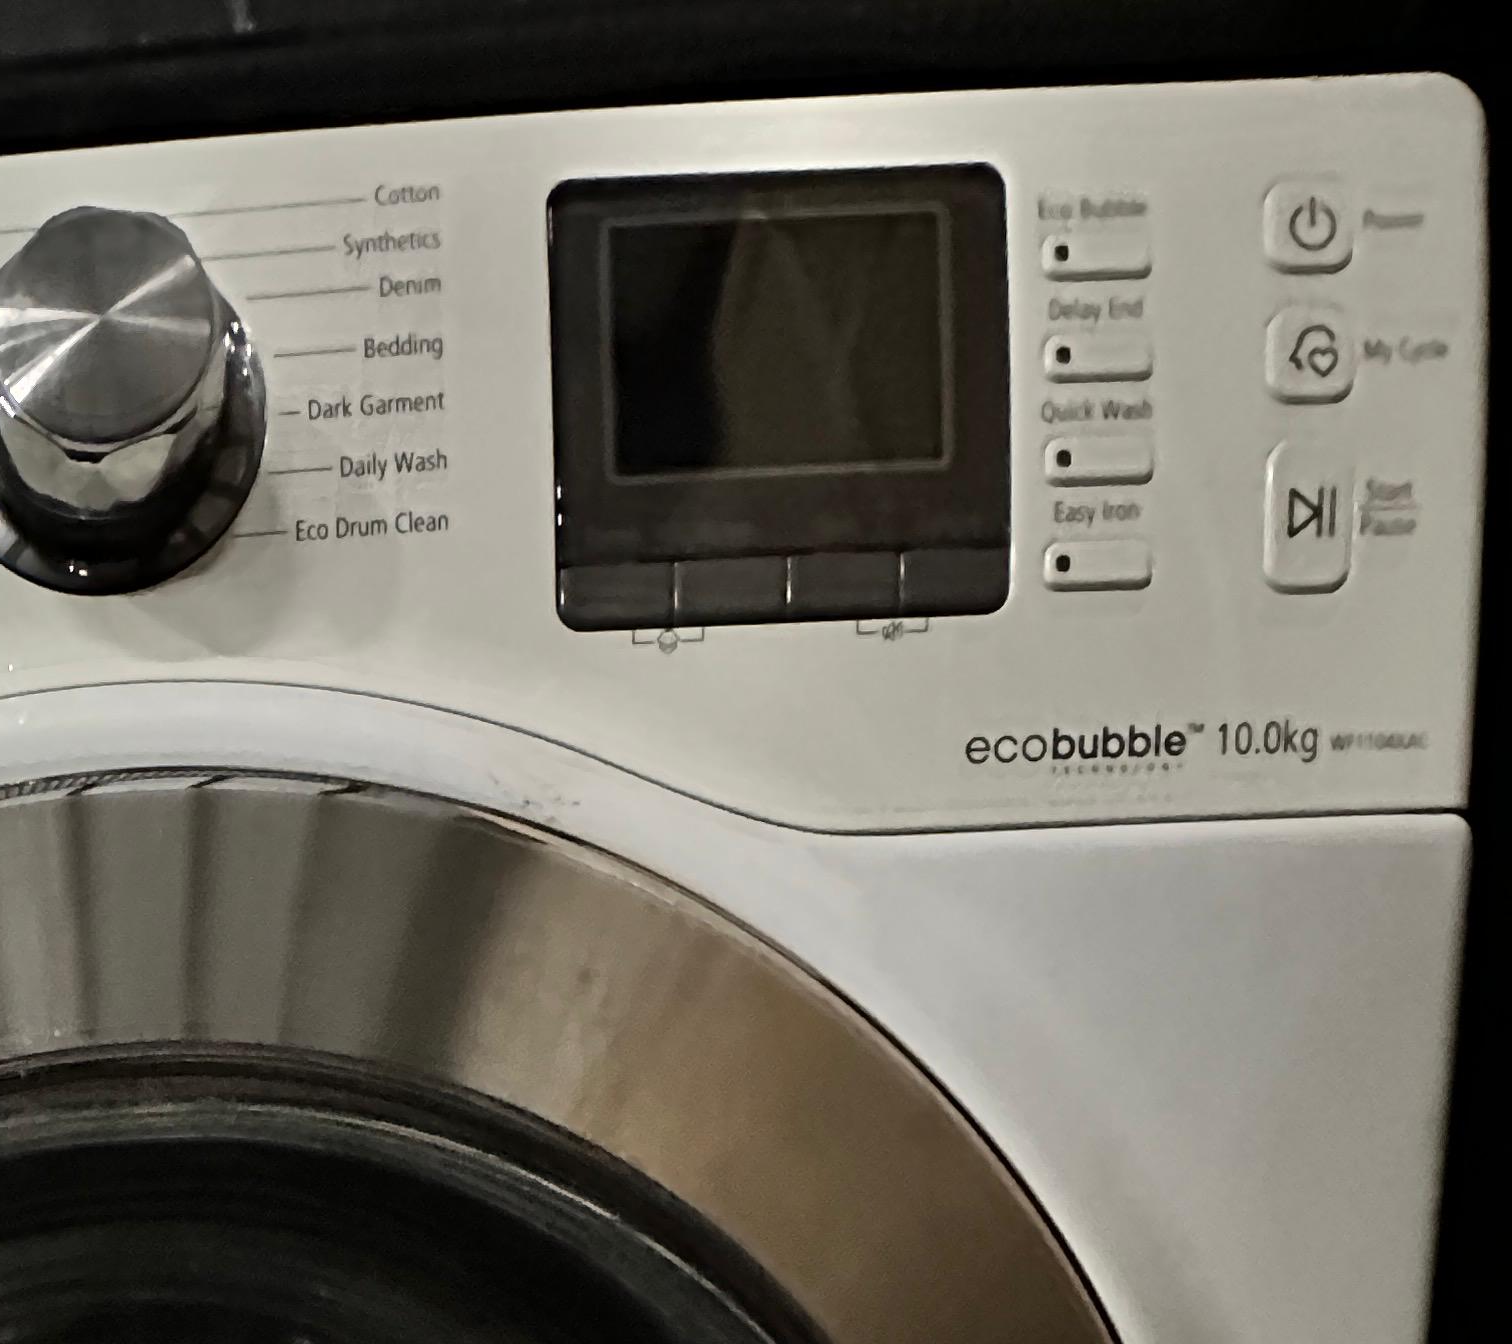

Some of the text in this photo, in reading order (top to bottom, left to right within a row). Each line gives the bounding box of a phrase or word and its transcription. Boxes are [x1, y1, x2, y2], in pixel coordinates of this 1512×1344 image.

[374, 183, 440, 206] Cotton
[343, 230, 441, 261] Synthetics
[379, 275, 442, 298] Denim
[364, 331, 444, 361] Bedding
[307, 391, 445, 421] Dark Garment
[339, 448, 448, 482] Daily Wash
[295, 510, 449, 542] Eco Drum Clean
[1053, 500, 1141, 529] Easy Iron
[1217, 719, 1319, 764] 10.0kg
